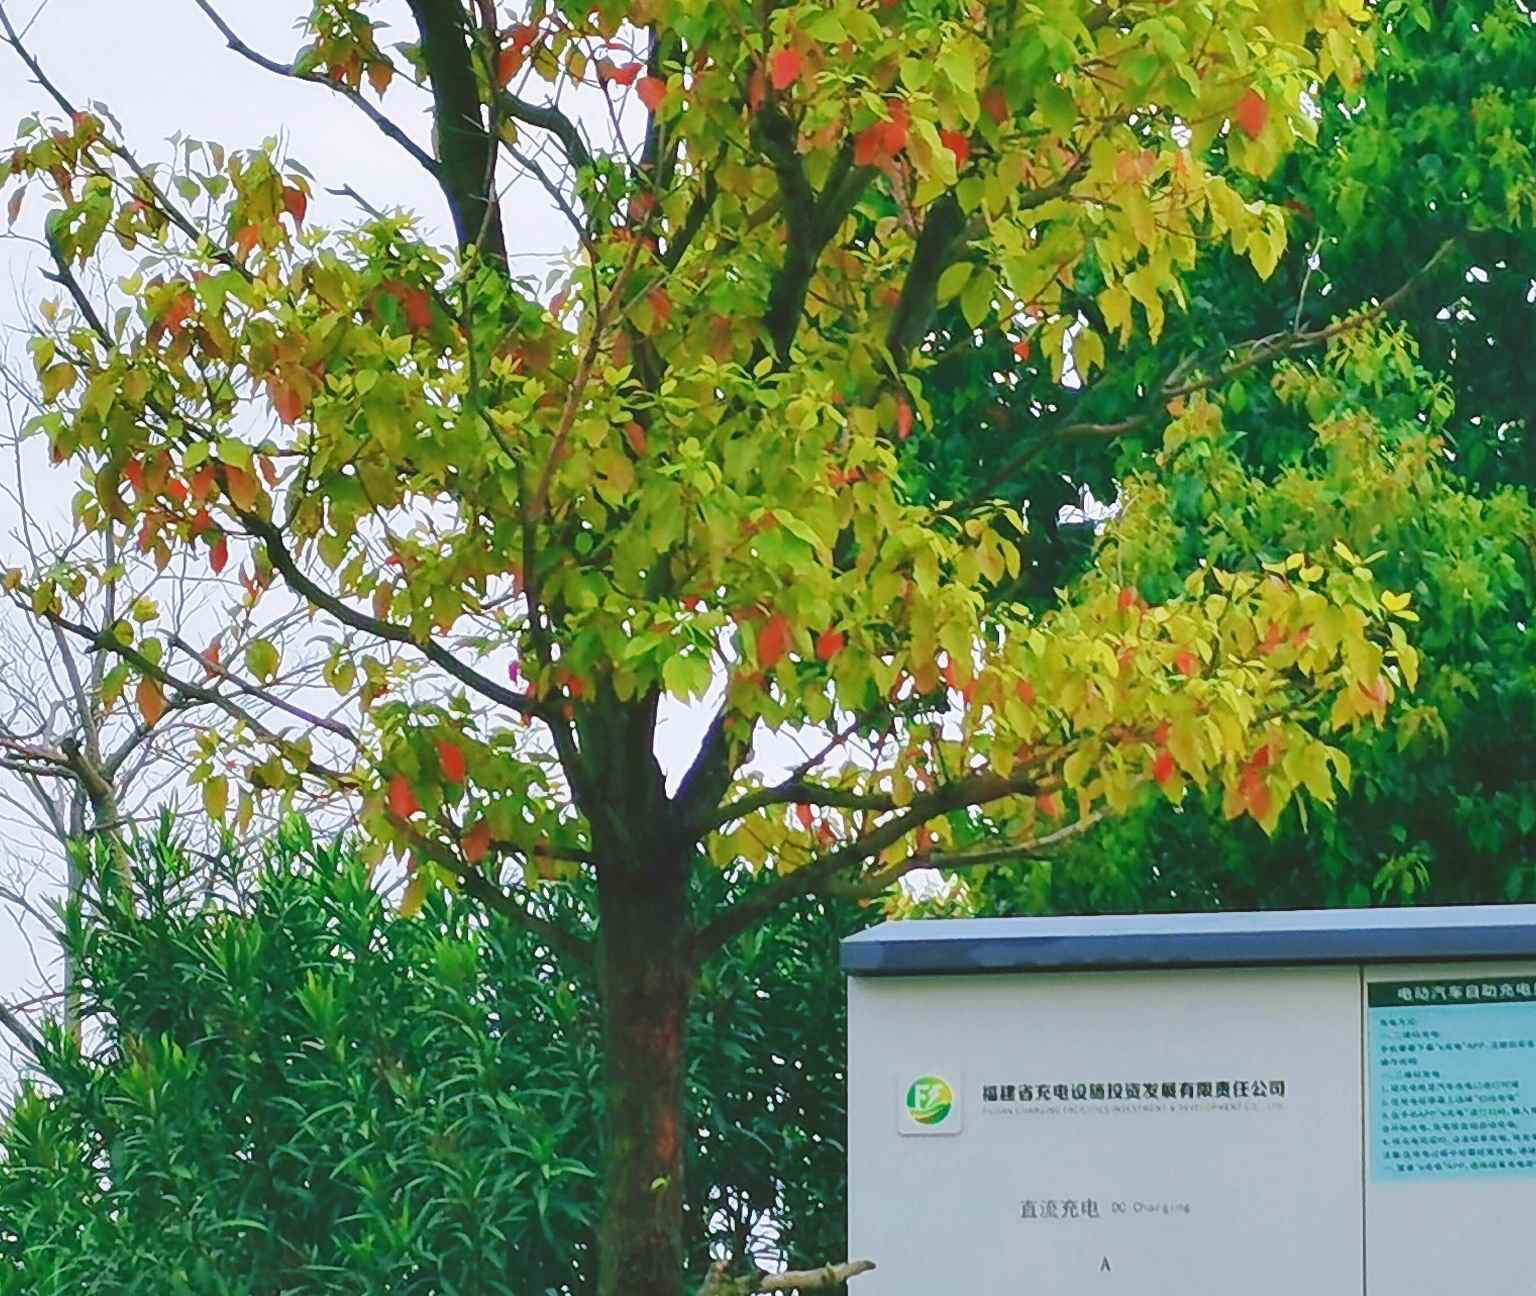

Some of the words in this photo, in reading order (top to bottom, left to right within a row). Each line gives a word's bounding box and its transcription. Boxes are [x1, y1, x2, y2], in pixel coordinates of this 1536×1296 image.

[1020, 1198, 1100, 1219] 直流充电
[1133, 1201, 1191, 1215] Charging
[1100, 1256, 1112, 1272] A
